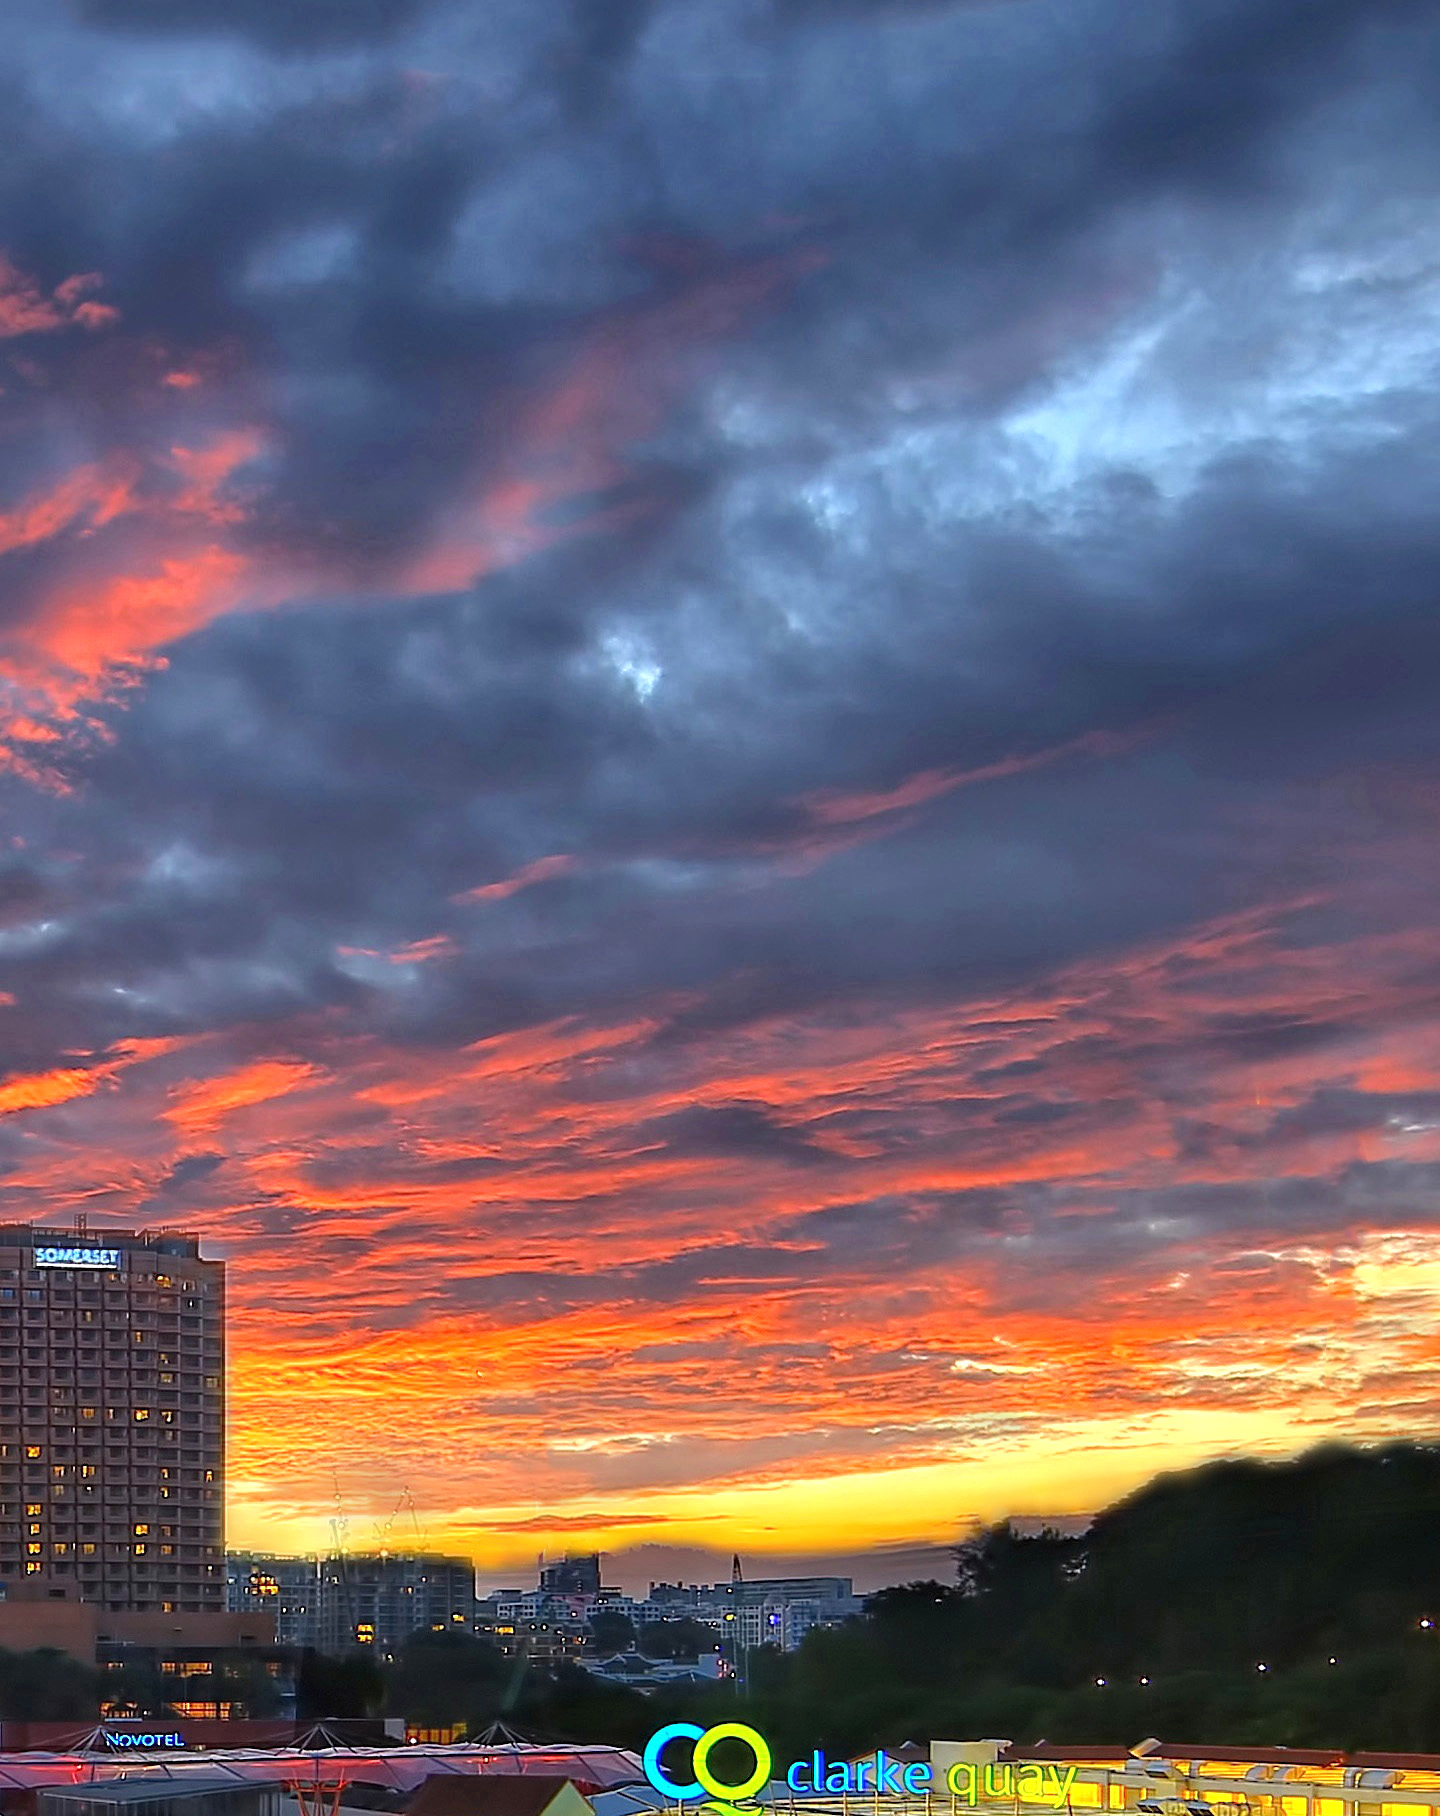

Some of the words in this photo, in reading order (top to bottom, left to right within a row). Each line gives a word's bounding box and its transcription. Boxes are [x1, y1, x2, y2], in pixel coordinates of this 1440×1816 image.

[35, 1247, 119, 1264] SOMERSET
[106, 1732, 185, 1747] NOVOTEL
[787, 1749, 934, 1796] clarke
[946, 1762, 1079, 1808] quay
